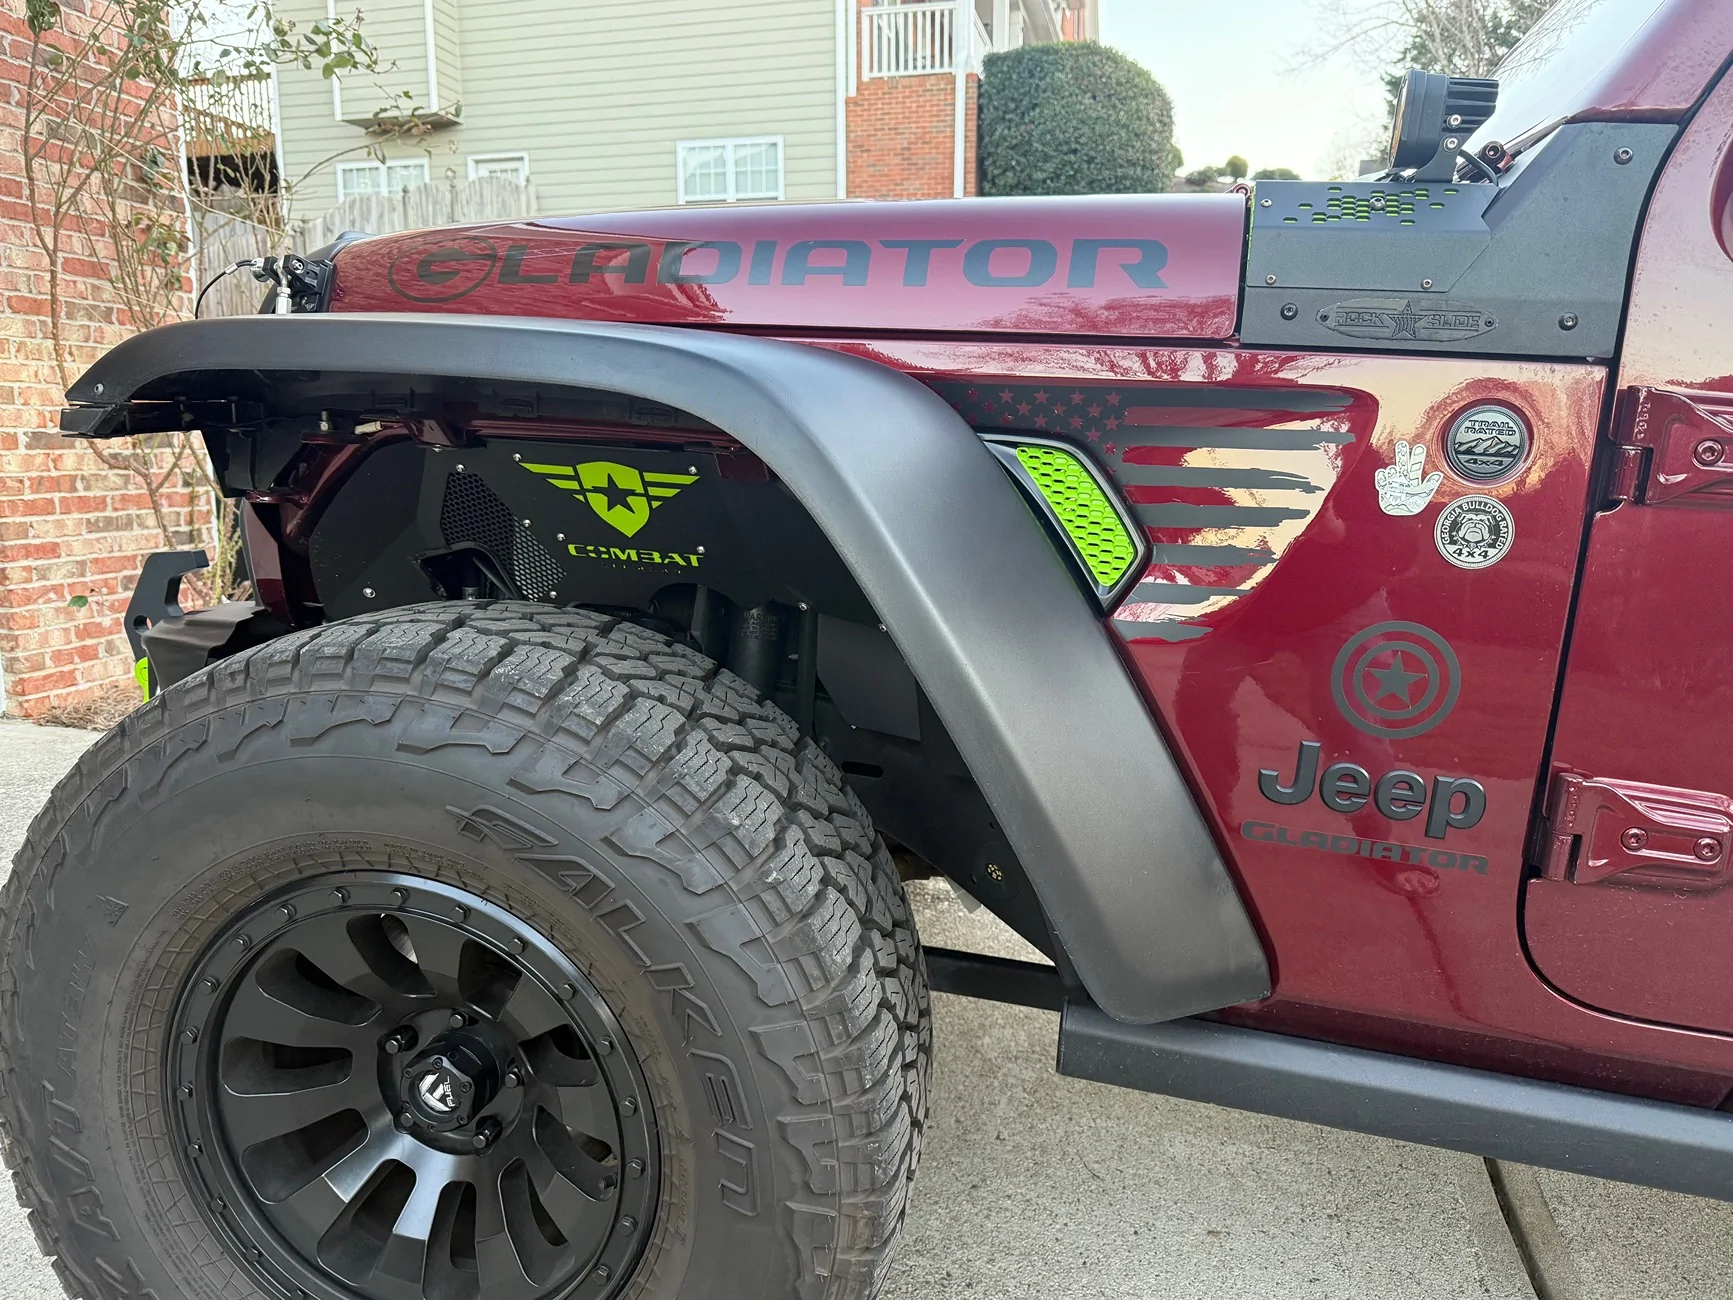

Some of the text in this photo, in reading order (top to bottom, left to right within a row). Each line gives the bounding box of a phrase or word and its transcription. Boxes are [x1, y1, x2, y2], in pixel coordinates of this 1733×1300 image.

[408, 238, 1169, 292] GLADIATOR
[1334, 311, 1481, 328] ROCK SLIDE
[1464, 426, 1517, 437] RATED
[1468, 419, 1514, 430] TRAIL
[1464, 458, 1504, 468] 4x4
[1441, 500, 1509, 549] GEORGIA BULLDOG RATED
[567, 543, 704, 567] COMBAT
[1452, 549, 1490, 559] 4x4
[1258, 740, 1487, 840] Jeep
[1240, 819, 1489, 876] GLADIATOR
[443, 1075, 456, 1107] FUEL
